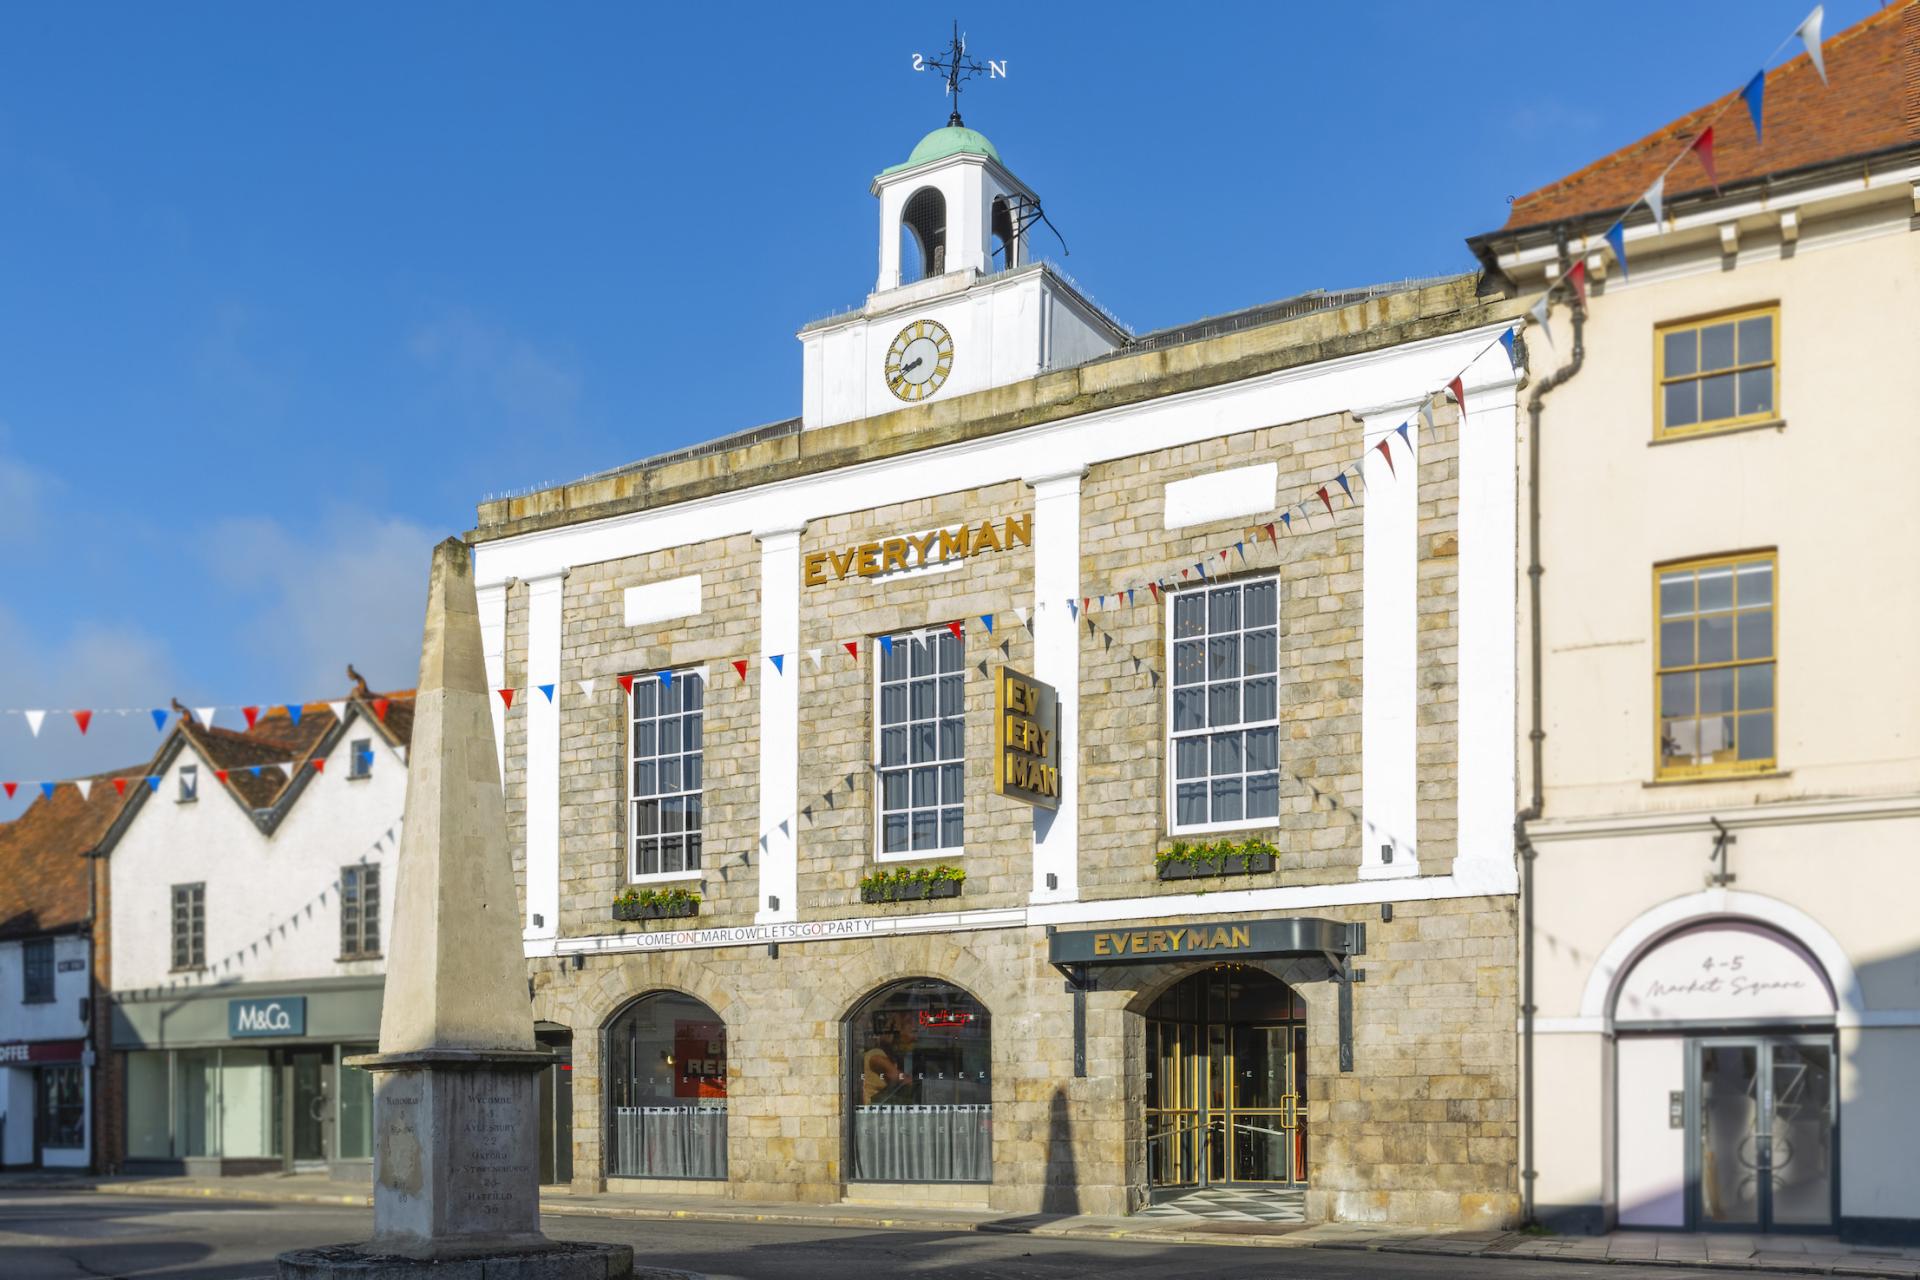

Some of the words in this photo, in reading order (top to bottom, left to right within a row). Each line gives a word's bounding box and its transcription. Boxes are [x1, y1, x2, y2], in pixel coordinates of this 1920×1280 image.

[988, 60, 1008, 78] N
[804, 514, 1032, 587] EVERYMAN
[1006, 677, 1040, 717] EV
[1006, 715, 1052, 758] ERY
[1006, 752, 1059, 798] MAN
[637, 934, 671, 946] COME
[677, 932, 694, 944] ON
[701, 928, 757, 943] MARLOW
[764, 925, 796, 938] LETS
[802, 923, 820, 935] GO
[829, 920, 872, 934] PARTY
[1094, 925, 1250, 955] EVERYMAN
[1646, 977, 1724, 997] Market
[1730, 976, 1806, 997] Square
